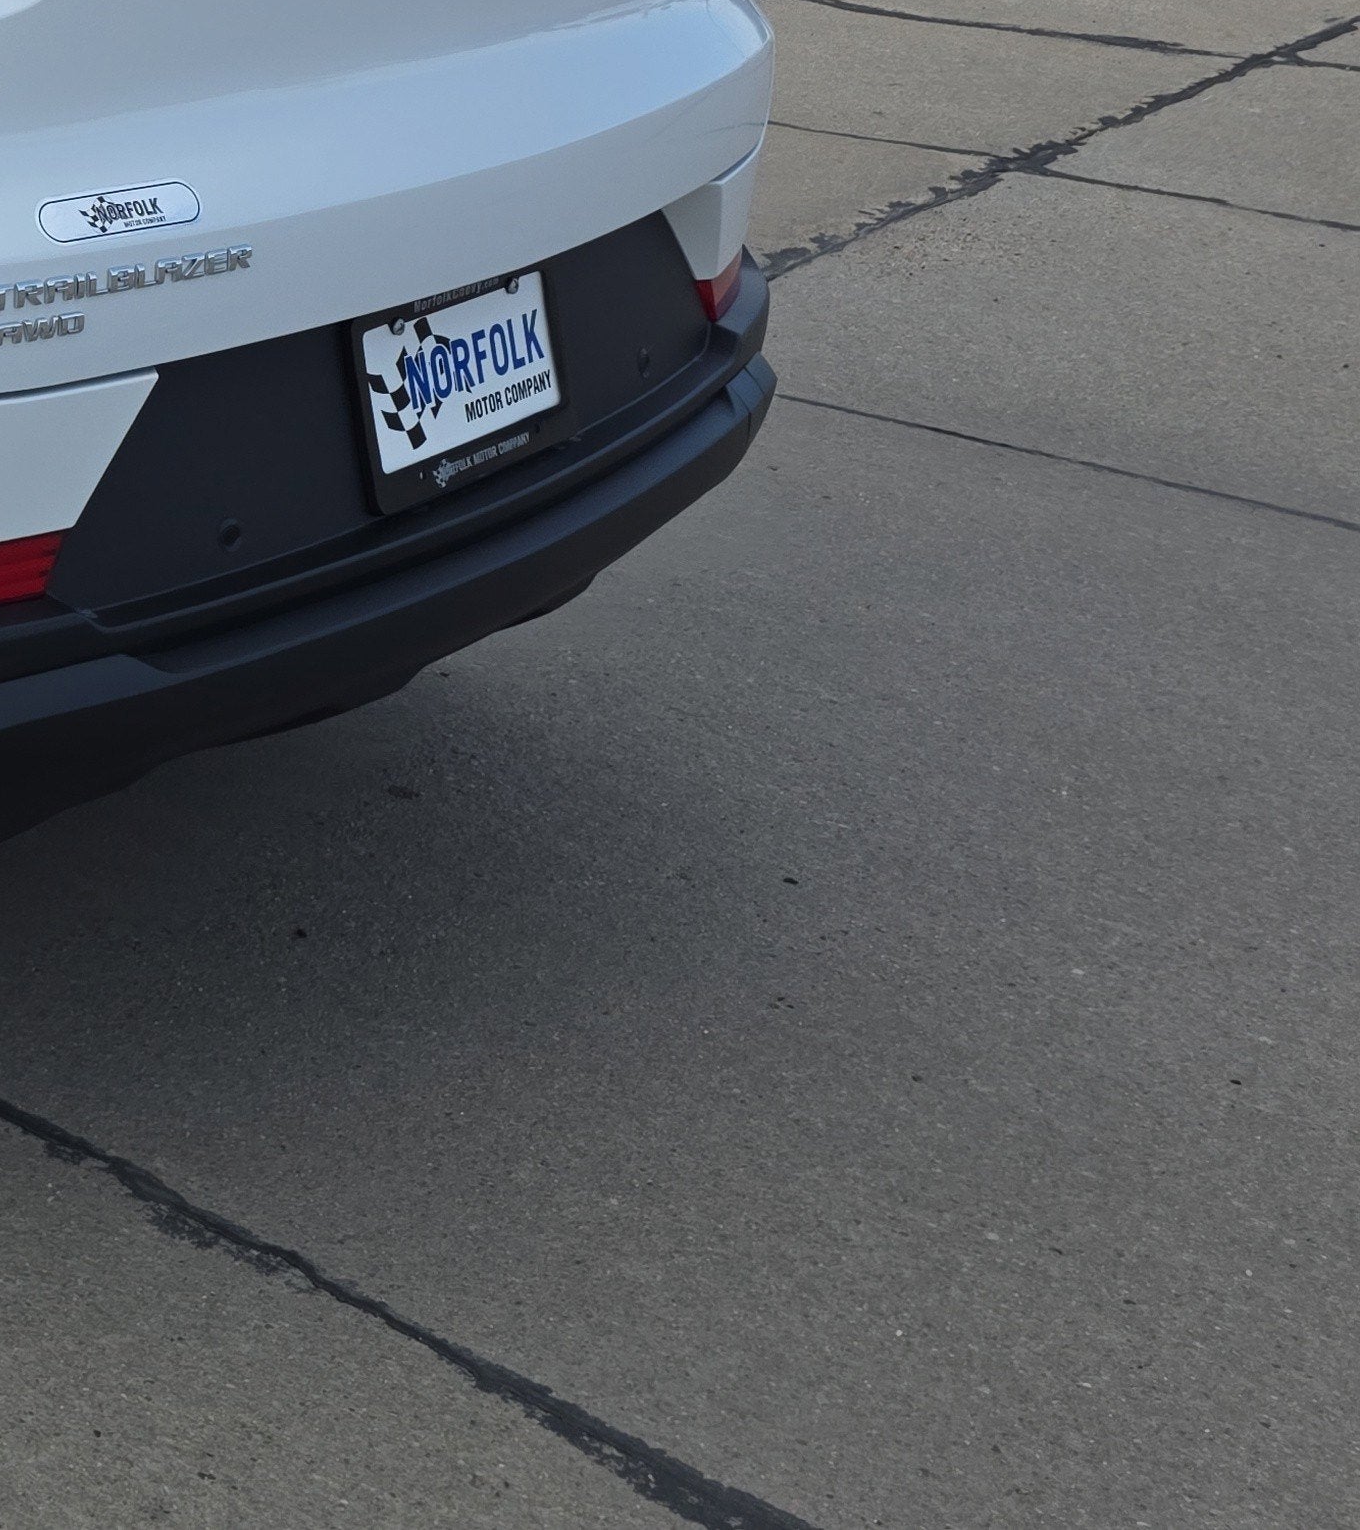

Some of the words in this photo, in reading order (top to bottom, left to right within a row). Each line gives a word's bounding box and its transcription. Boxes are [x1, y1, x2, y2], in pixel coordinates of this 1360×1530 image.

[95, 197, 164, 225] NORFOLK
[404, 308, 545, 410] NORFOLK
[464, 391, 503, 423] MOTOR
[504, 369, 552, 410] COMPANY
[473, 445, 498, 467] MOTOR
[498, 431, 530, 456] COMPANY
